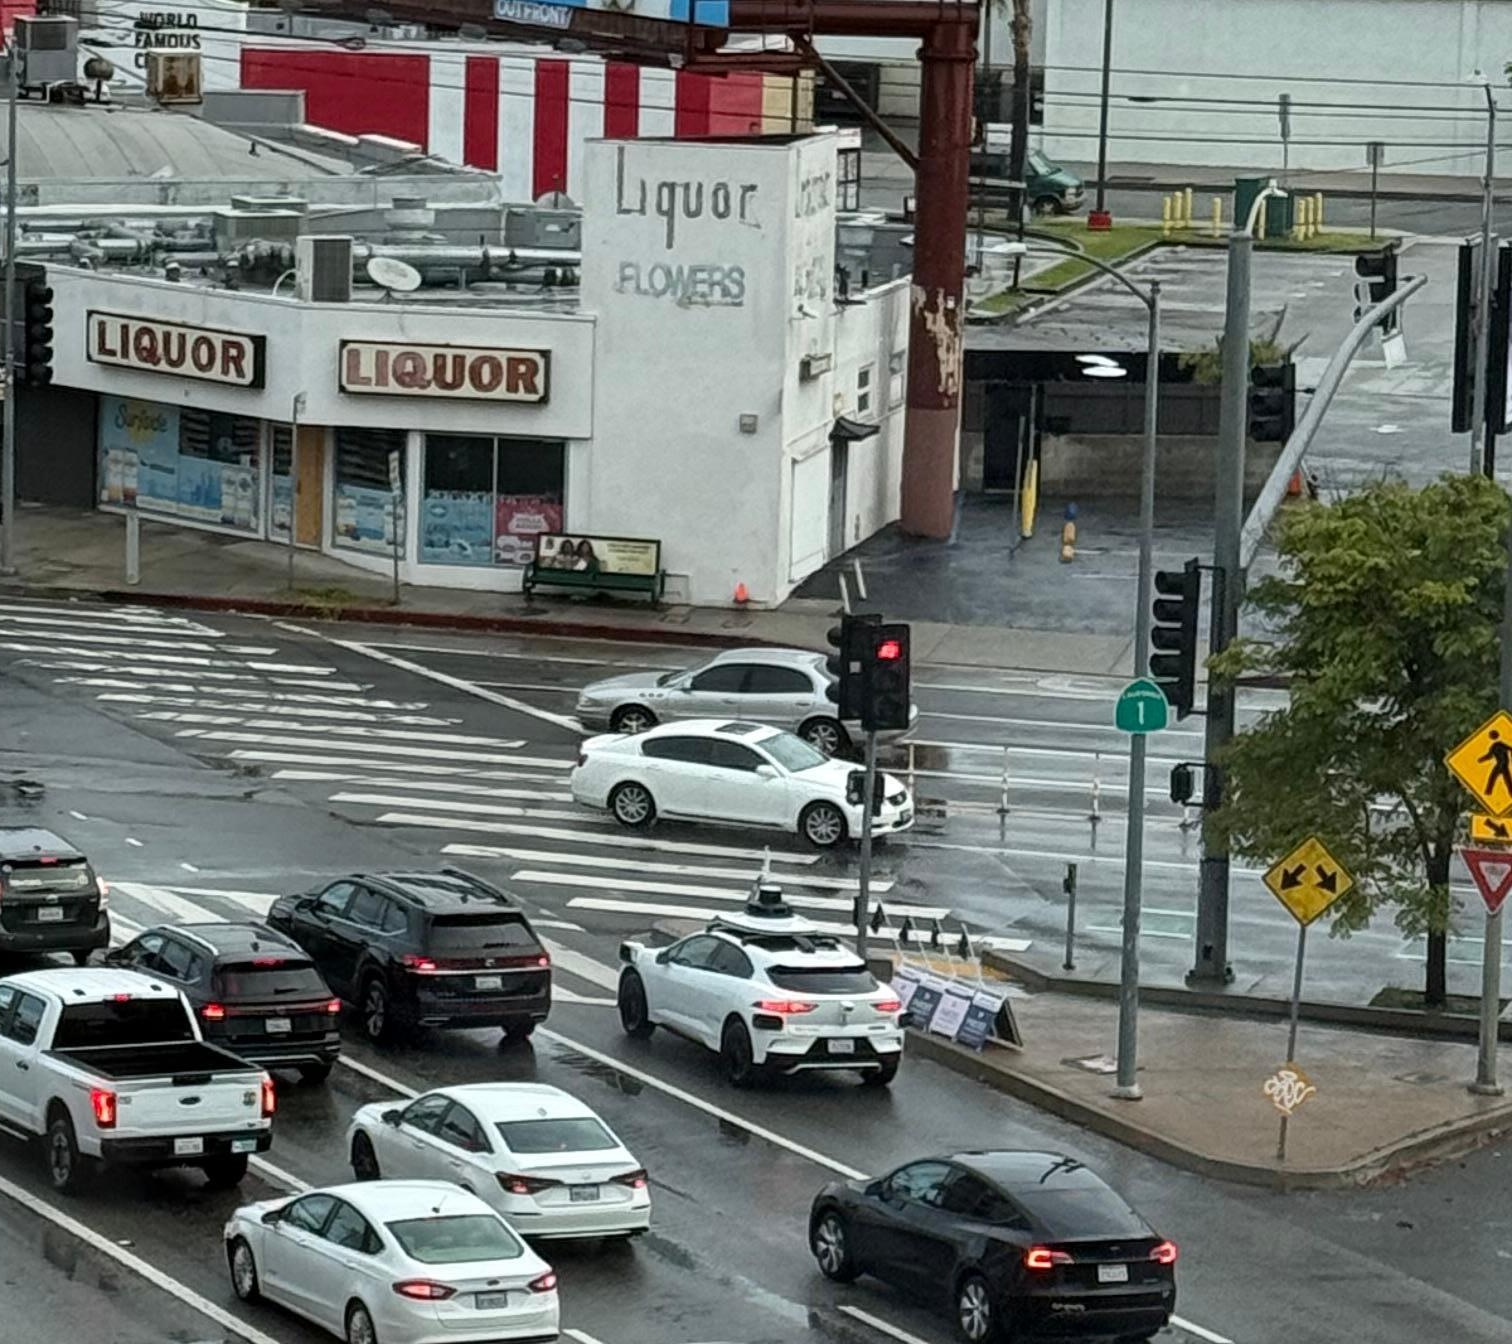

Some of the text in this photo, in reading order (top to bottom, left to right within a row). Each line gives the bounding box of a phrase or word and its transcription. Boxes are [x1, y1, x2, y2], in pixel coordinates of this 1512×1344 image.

[139, 11, 198, 29] WORLD
[135, 32, 201, 49] FAMOUS
[616, 146, 759, 249] Liquor
[97, 320, 246, 379] LIQUOR
[346, 348, 539, 395] LIQUOR
[1137, 701, 1145, 726] 1
